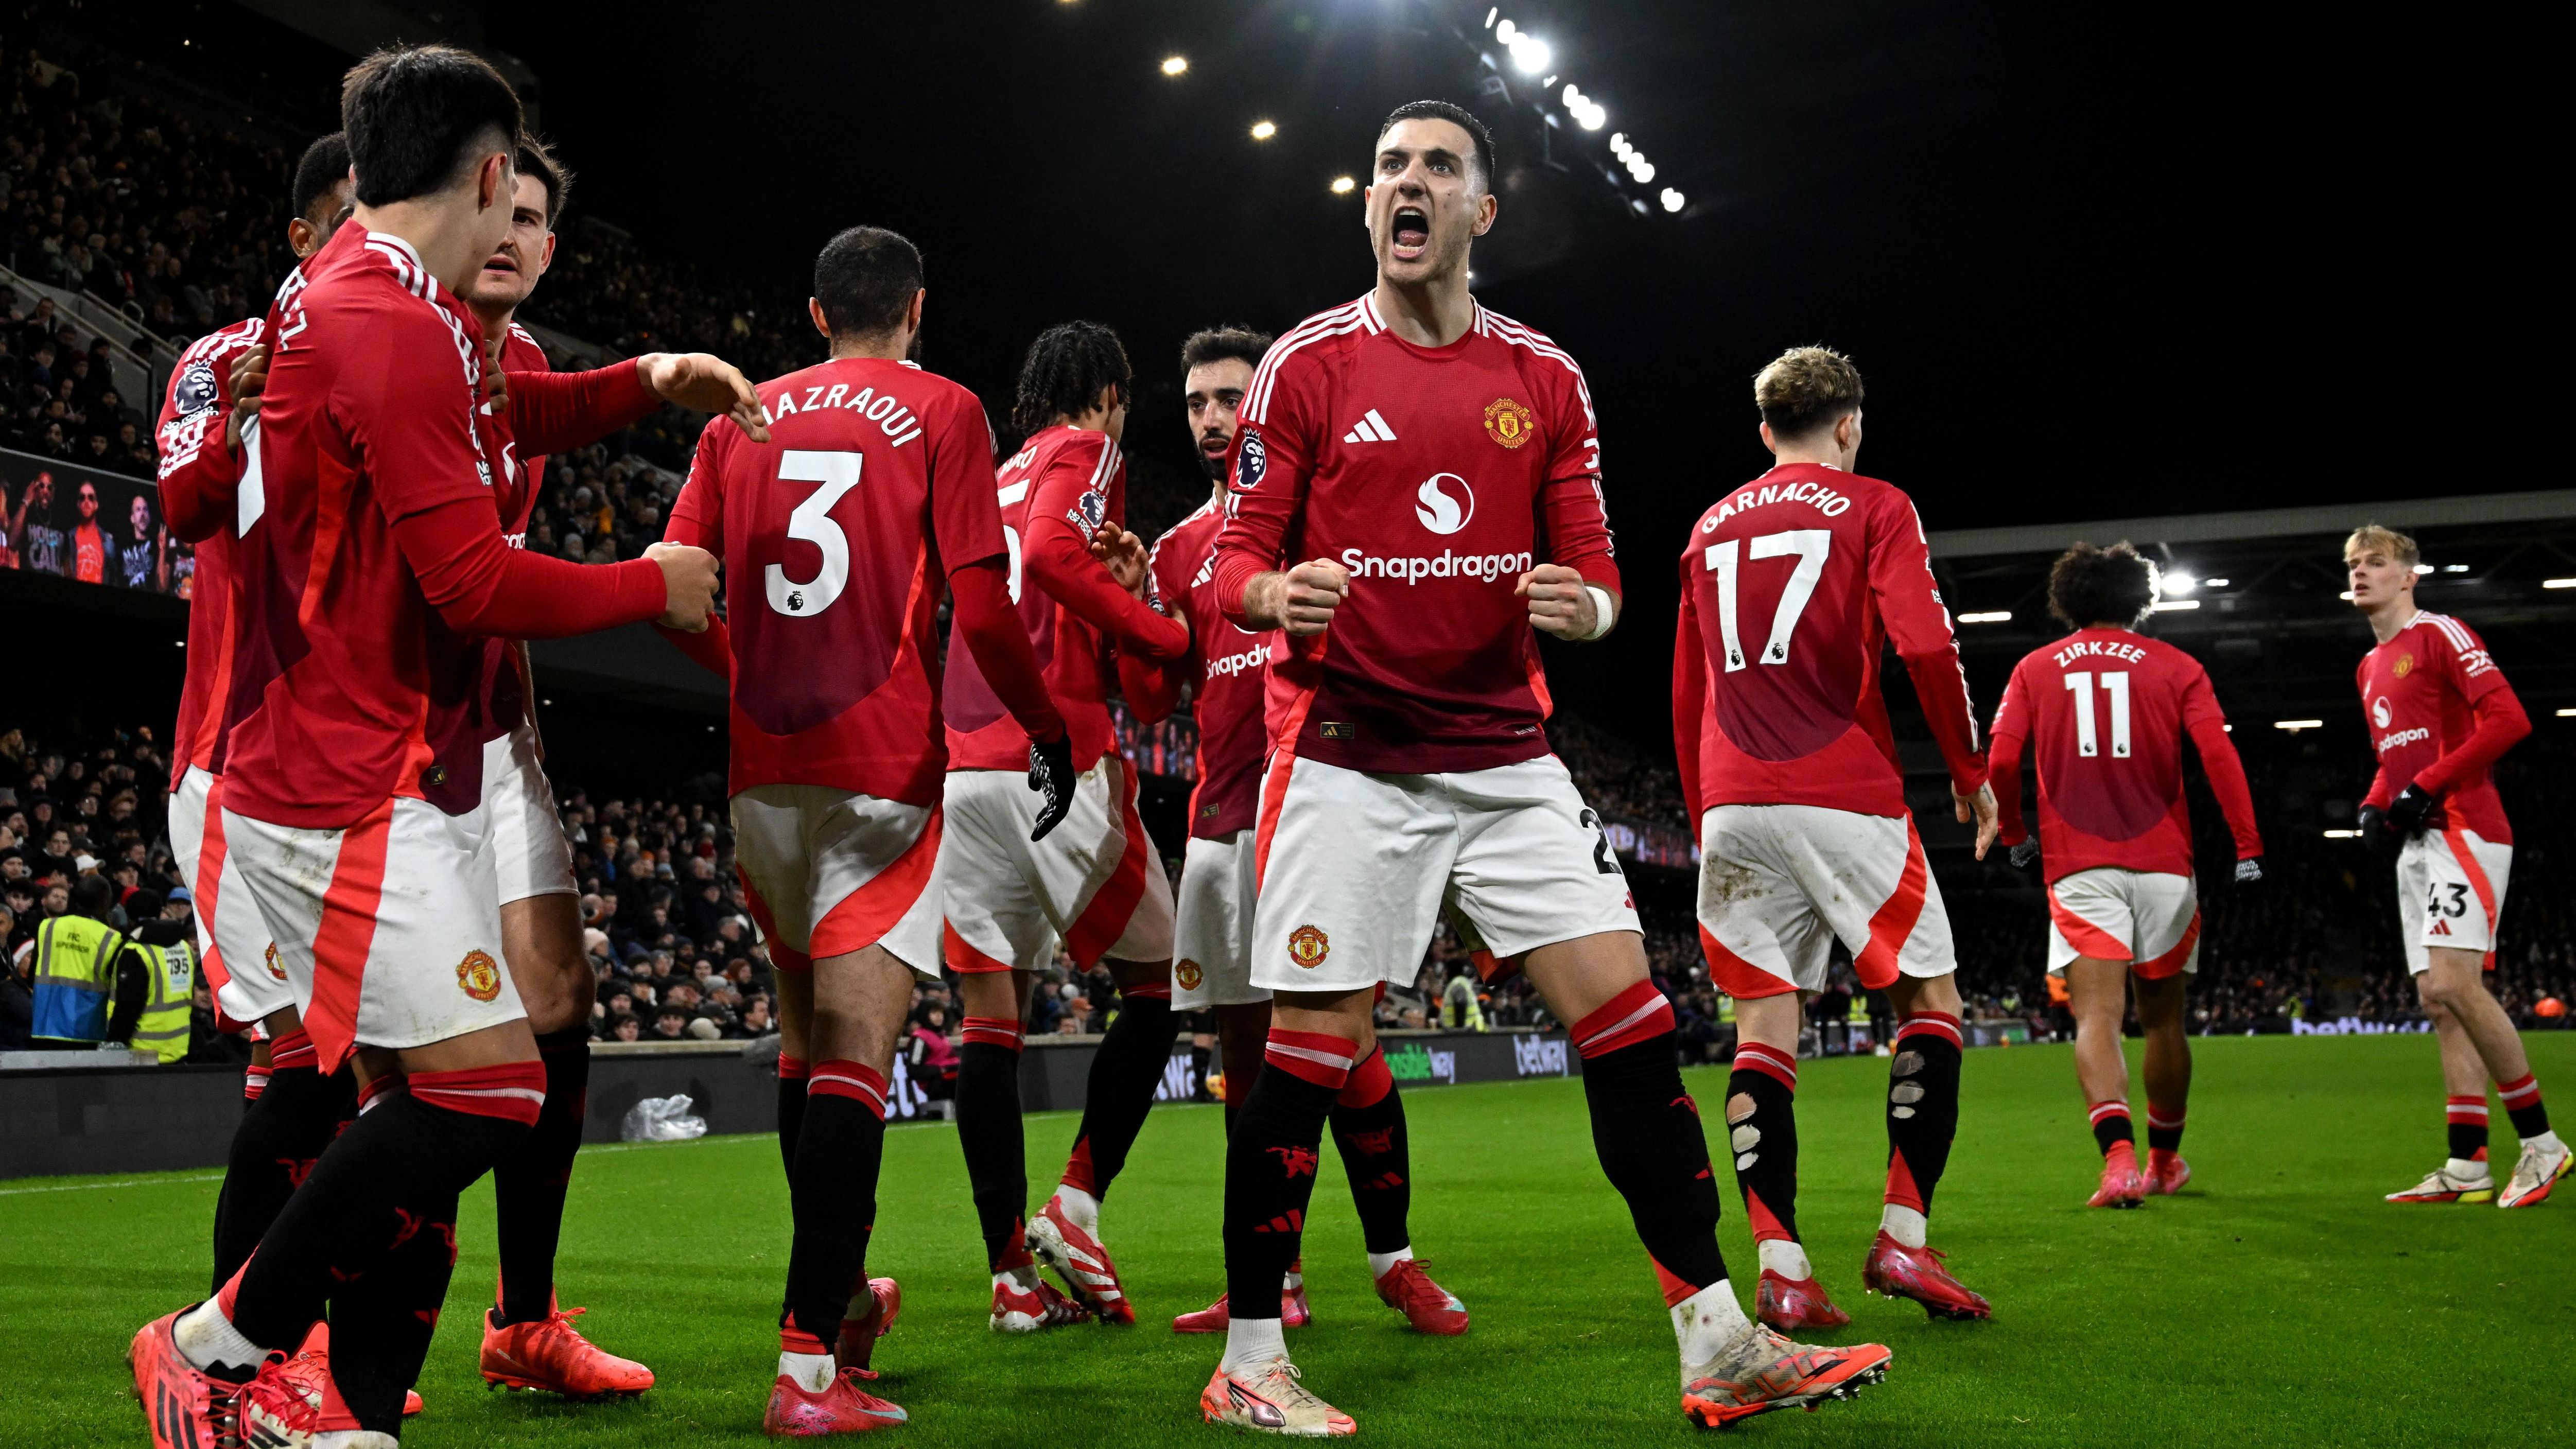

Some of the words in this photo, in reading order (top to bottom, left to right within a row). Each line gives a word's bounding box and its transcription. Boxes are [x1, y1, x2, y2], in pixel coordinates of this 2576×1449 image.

[1488, 401, 1527, 418] MANCHESTER
[1497, 435, 1524, 445] UNITED
[1701, 482, 1852, 534] GARNACHO
[765, 449, 863, 617] 3
[1342, 548, 1532, 586] Snapdragon
[1704, 529, 1832, 673] 17
[2053, 641, 2147, 668] ZIRKZEE
[2064, 671, 2131, 759] 11
[2428, 882, 2469, 918] 43
[1292, 928, 1325, 942] MANCHESTER
[166, 957, 189, 975] 795
[1297, 957, 1320, 966] UNITED
